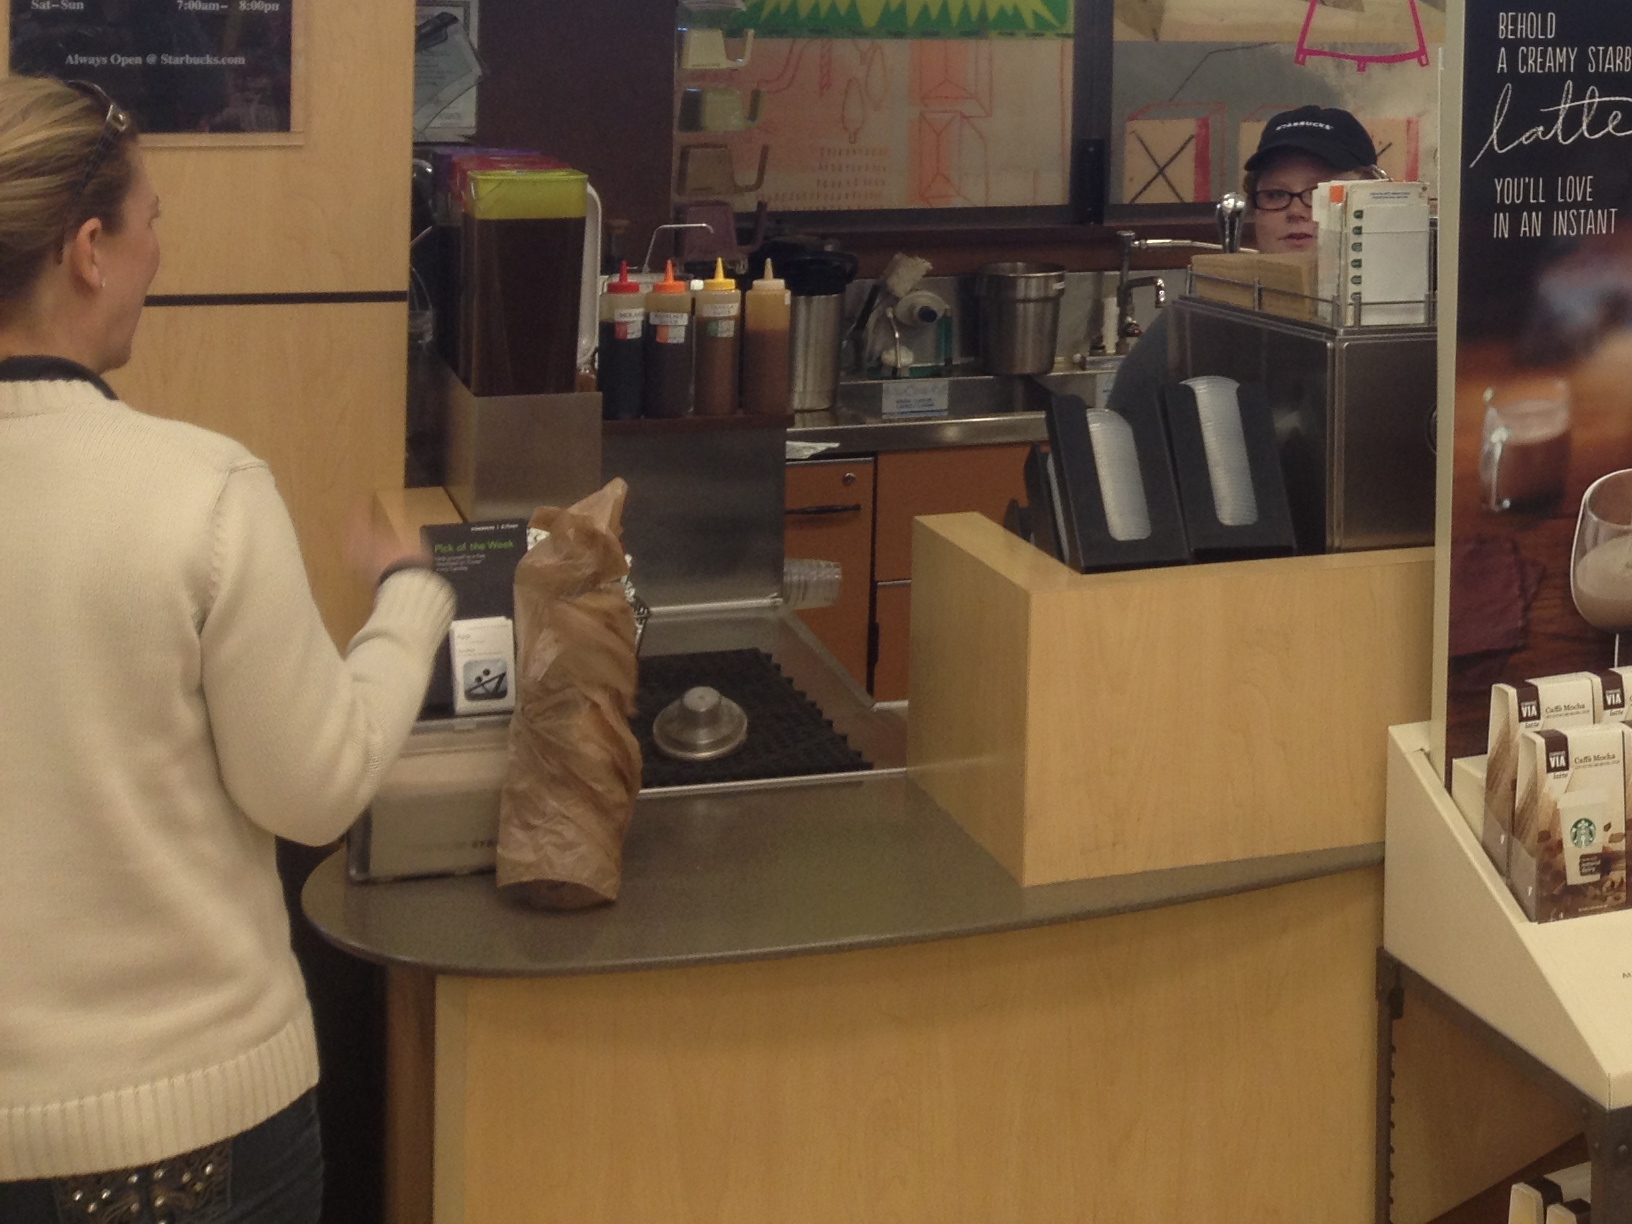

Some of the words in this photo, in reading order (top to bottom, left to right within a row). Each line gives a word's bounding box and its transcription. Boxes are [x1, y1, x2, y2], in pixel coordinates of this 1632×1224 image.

[1499, 12, 1557, 40] BEHOLD
[65, 54, 108, 67] Always
[110, 54, 143, 67] Open
[146, 54, 157, 65] @
[160, 54, 246, 66] Starbucks.com
[1497, 47, 1507, 74] A
[1518, 47, 1578, 74] CREAMY
[1275, 120, 1334, 131] STARBUCKS
[1494, 177, 1546, 205] YOU'LL
[1557, 176, 1594, 202] LOVE
[1493, 212, 1509, 239] IN
[1520, 211, 1541, 237] AN
[1552, 209, 1618, 236] INSTANT
[1605, 693, 1621, 706] VIA
[1521, 706, 1537, 718] VIA
[1563, 703, 1586, 712] Mocha
[1549, 756, 1566, 768] VIA
[1593, 753, 1616, 762] Mocha
